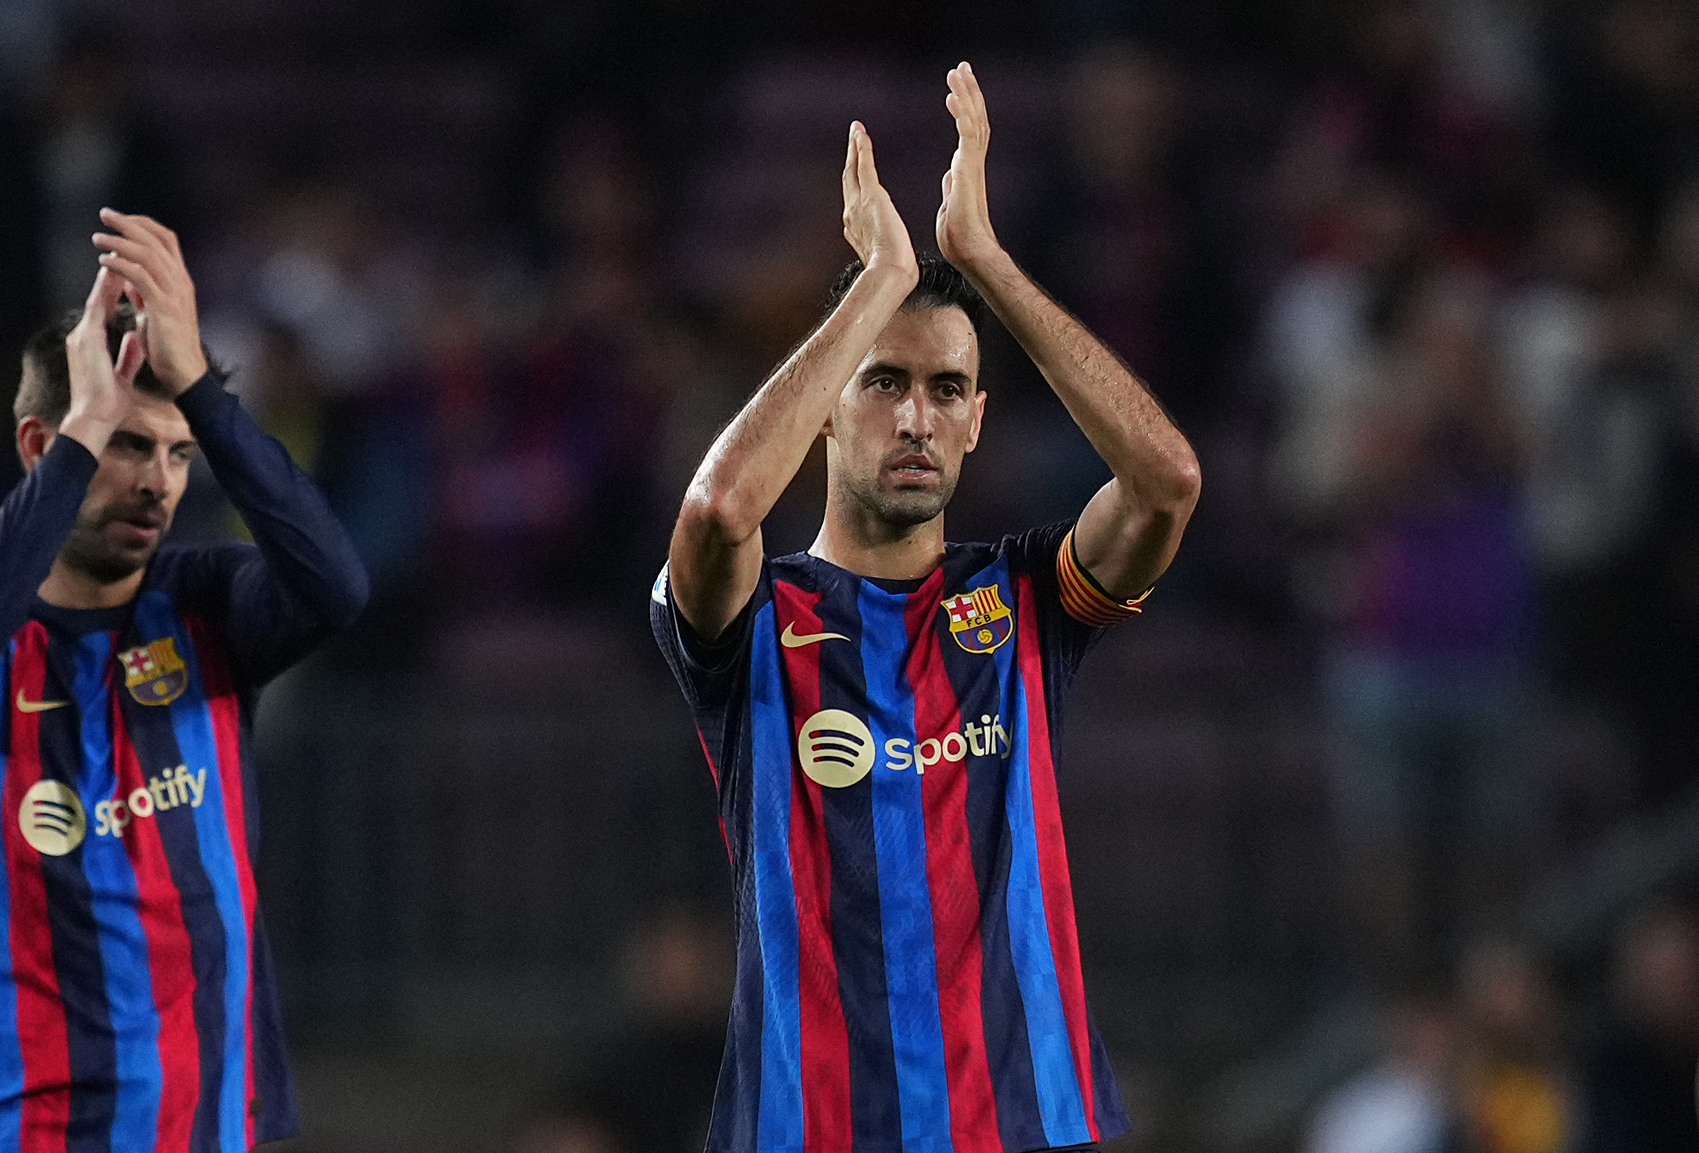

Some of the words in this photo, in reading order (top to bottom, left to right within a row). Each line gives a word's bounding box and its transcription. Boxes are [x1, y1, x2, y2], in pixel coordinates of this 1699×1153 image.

[966, 614, 992, 628] FCB
[884, 713, 1013, 775] Spotify
[95, 764, 207, 838] Spotify
